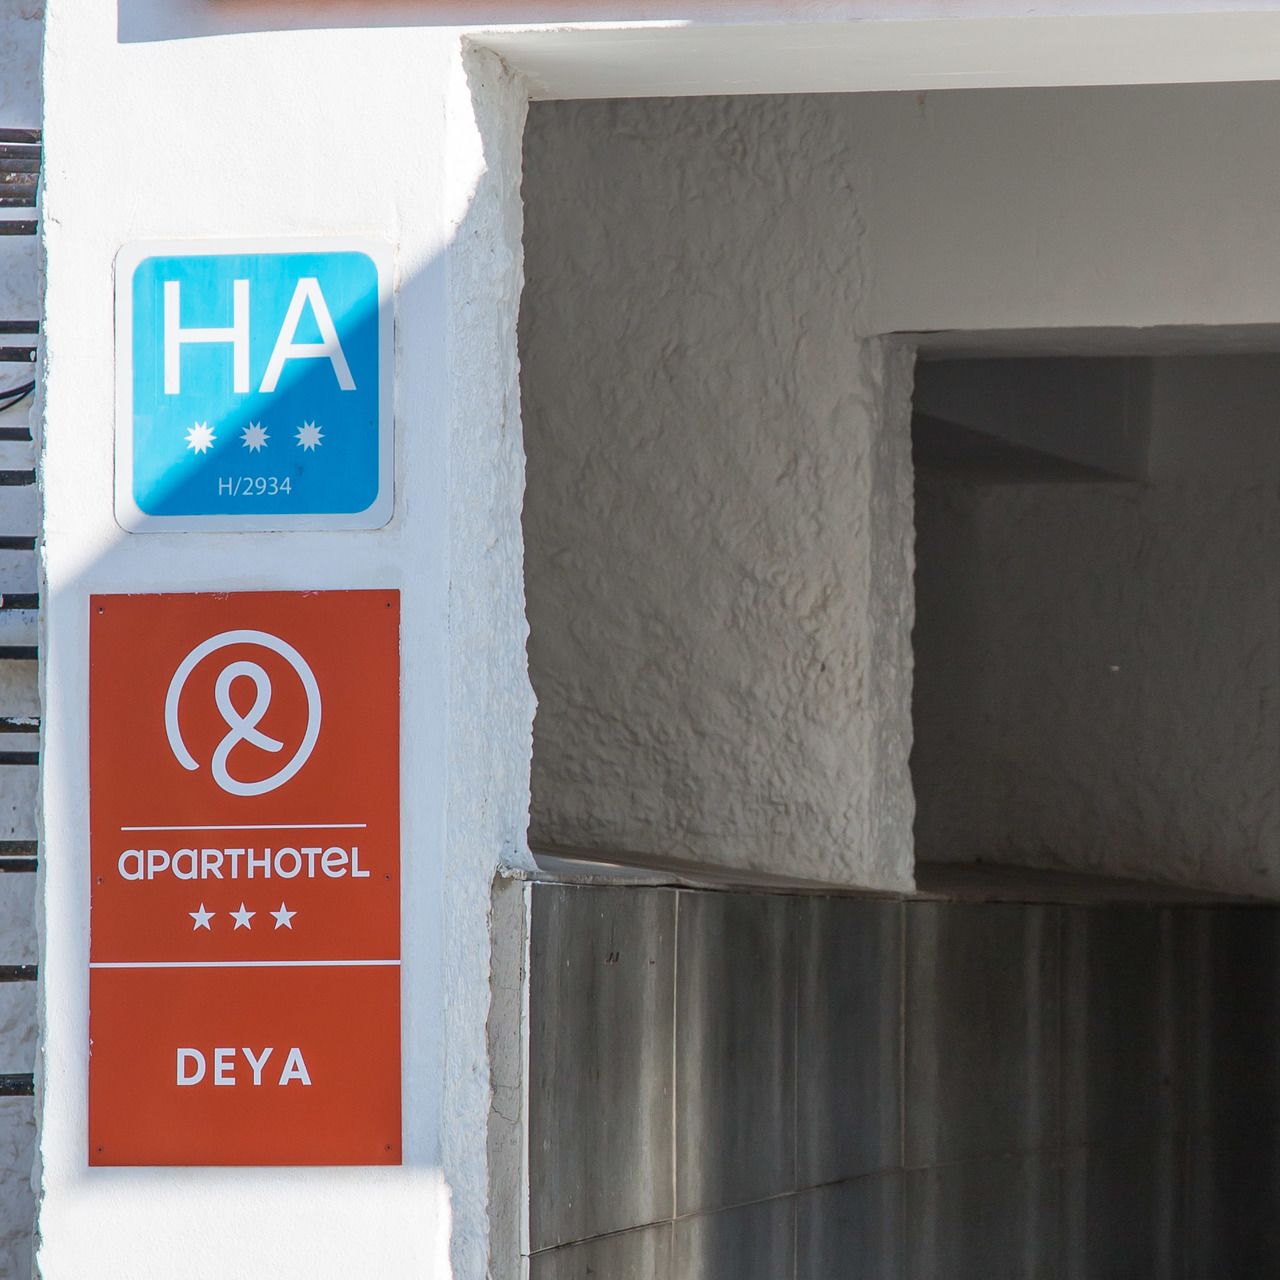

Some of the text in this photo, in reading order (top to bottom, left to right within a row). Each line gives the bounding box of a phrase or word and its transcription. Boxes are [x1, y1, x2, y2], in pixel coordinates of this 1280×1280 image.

[163, 277, 357, 395] HA
[218, 476, 292, 496] H/2934
[175, 1046, 312, 1086] DEYA
